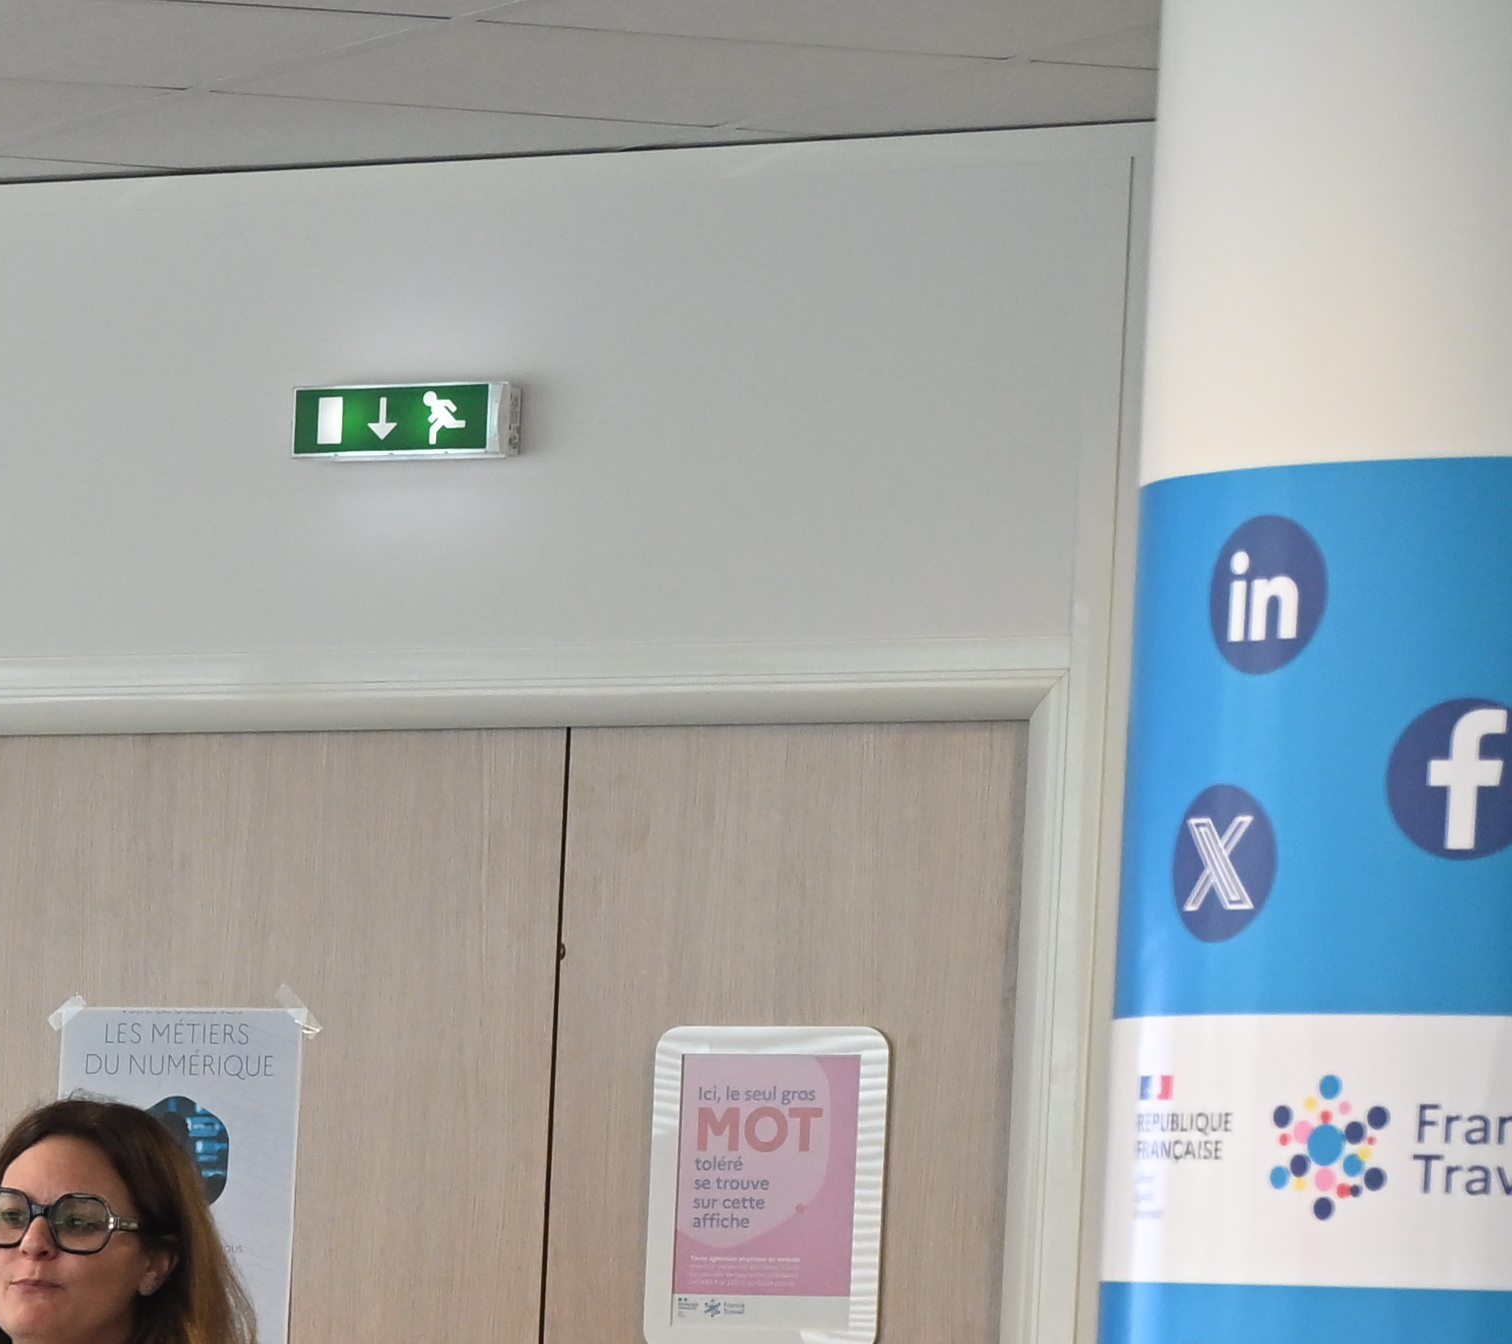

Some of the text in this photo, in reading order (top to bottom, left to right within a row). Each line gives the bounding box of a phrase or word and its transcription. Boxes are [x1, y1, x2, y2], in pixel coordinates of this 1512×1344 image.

[1226, 550, 1299, 643] in
[104, 1019, 250, 1046] LES MÉTIERS
[85, 1050, 274, 1080] DU NUMÉRIQUE
[698, 1086, 816, 1105] Ici, le seul gros
[697, 1106, 823, 1153] MOT
[694, 1156, 743, 1171] toléré
[694, 1177, 769, 1190] se trouve
[693, 1196, 765, 1210] sur cette
[692, 1213, 750, 1229] affiche
